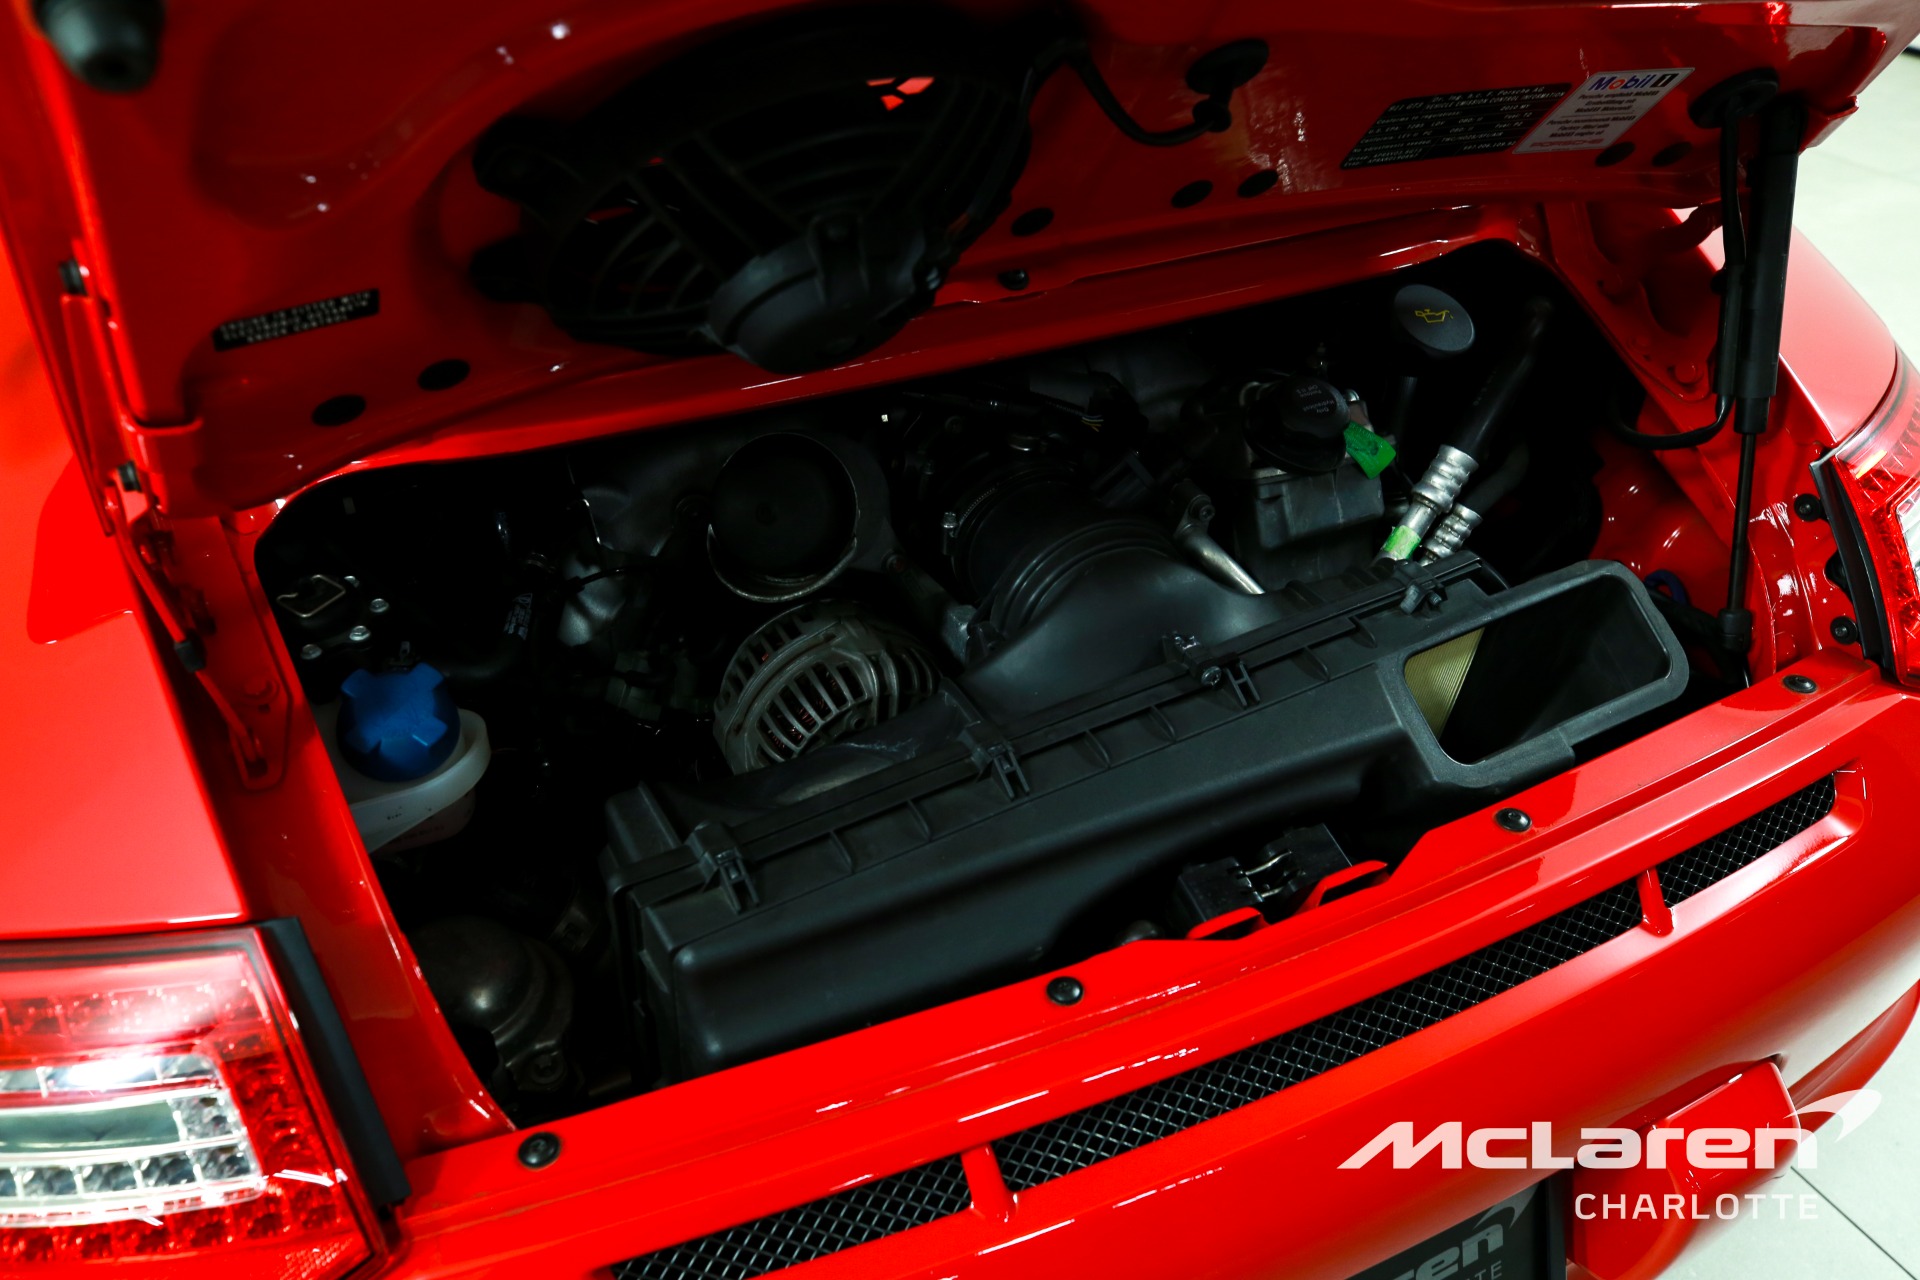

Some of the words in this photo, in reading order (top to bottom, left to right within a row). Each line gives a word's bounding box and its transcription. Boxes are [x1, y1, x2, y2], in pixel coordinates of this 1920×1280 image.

[1588, 75, 1657, 91] Mobil
[1497, 88, 1531, 96] Porsche
[1529, 138, 1604, 147] PORSCHE
